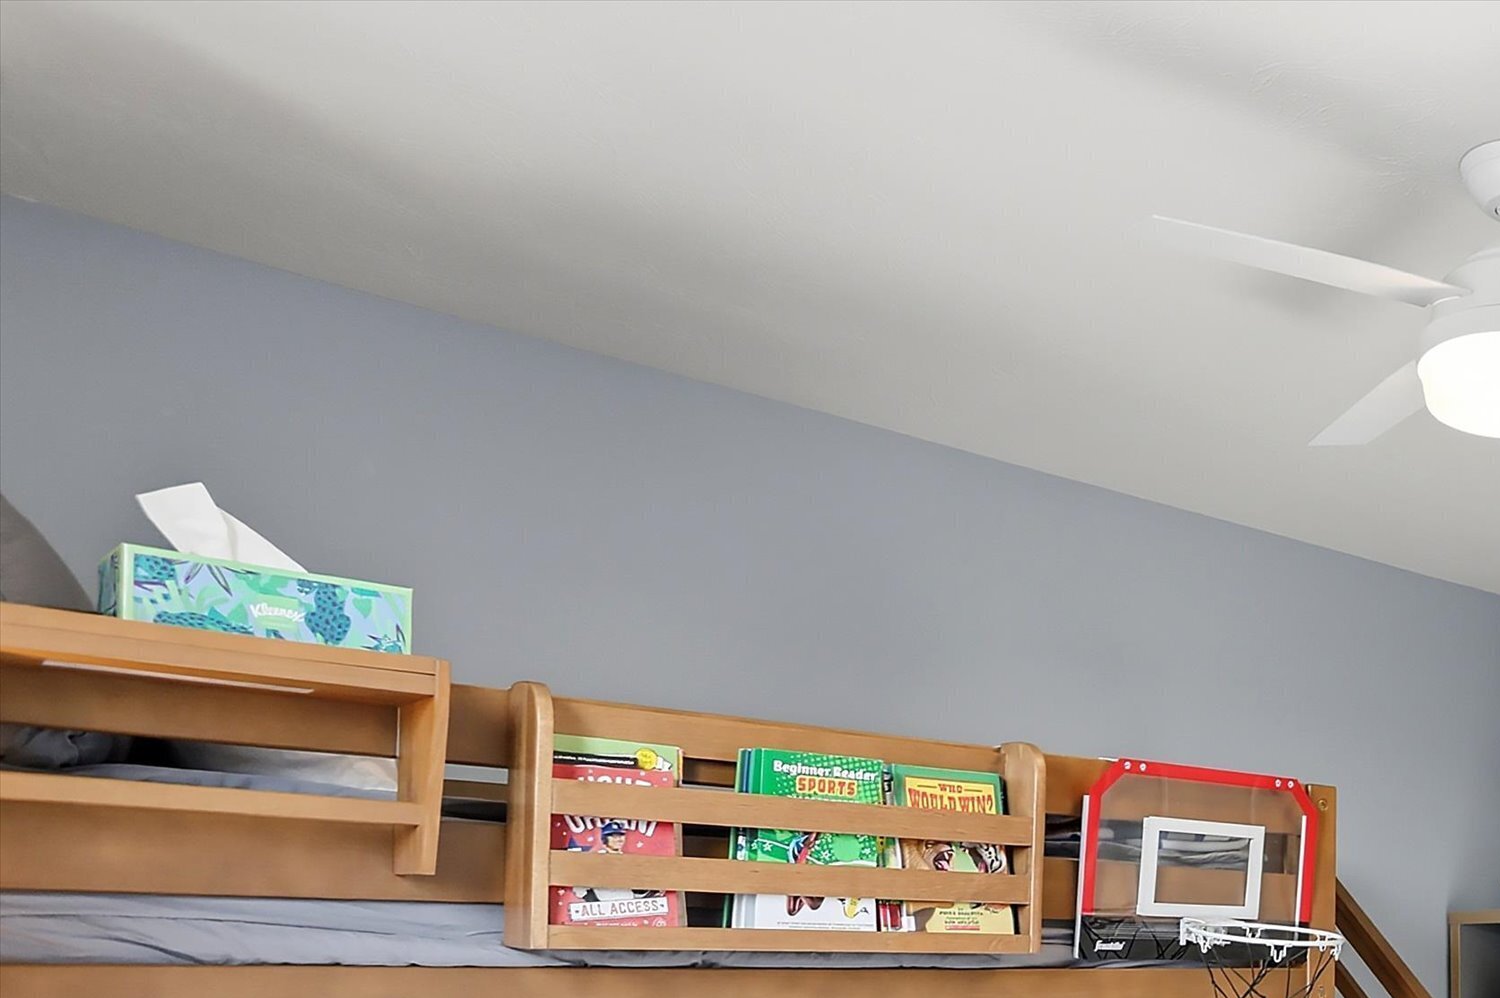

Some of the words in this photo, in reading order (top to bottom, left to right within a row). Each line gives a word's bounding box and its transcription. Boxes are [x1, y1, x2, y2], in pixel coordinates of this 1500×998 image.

[773, 760, 832, 776] Beginner
[833, 766, 879, 782] Reader
[797, 776, 857, 797] SPORTS
[938, 783, 963, 794] WHO
[908, 788, 957, 813] WOULD
[958, 794, 994, 814] WIN?
[580, 904, 606, 917] ALL
[610, 899, 660, 912] ACCESS
